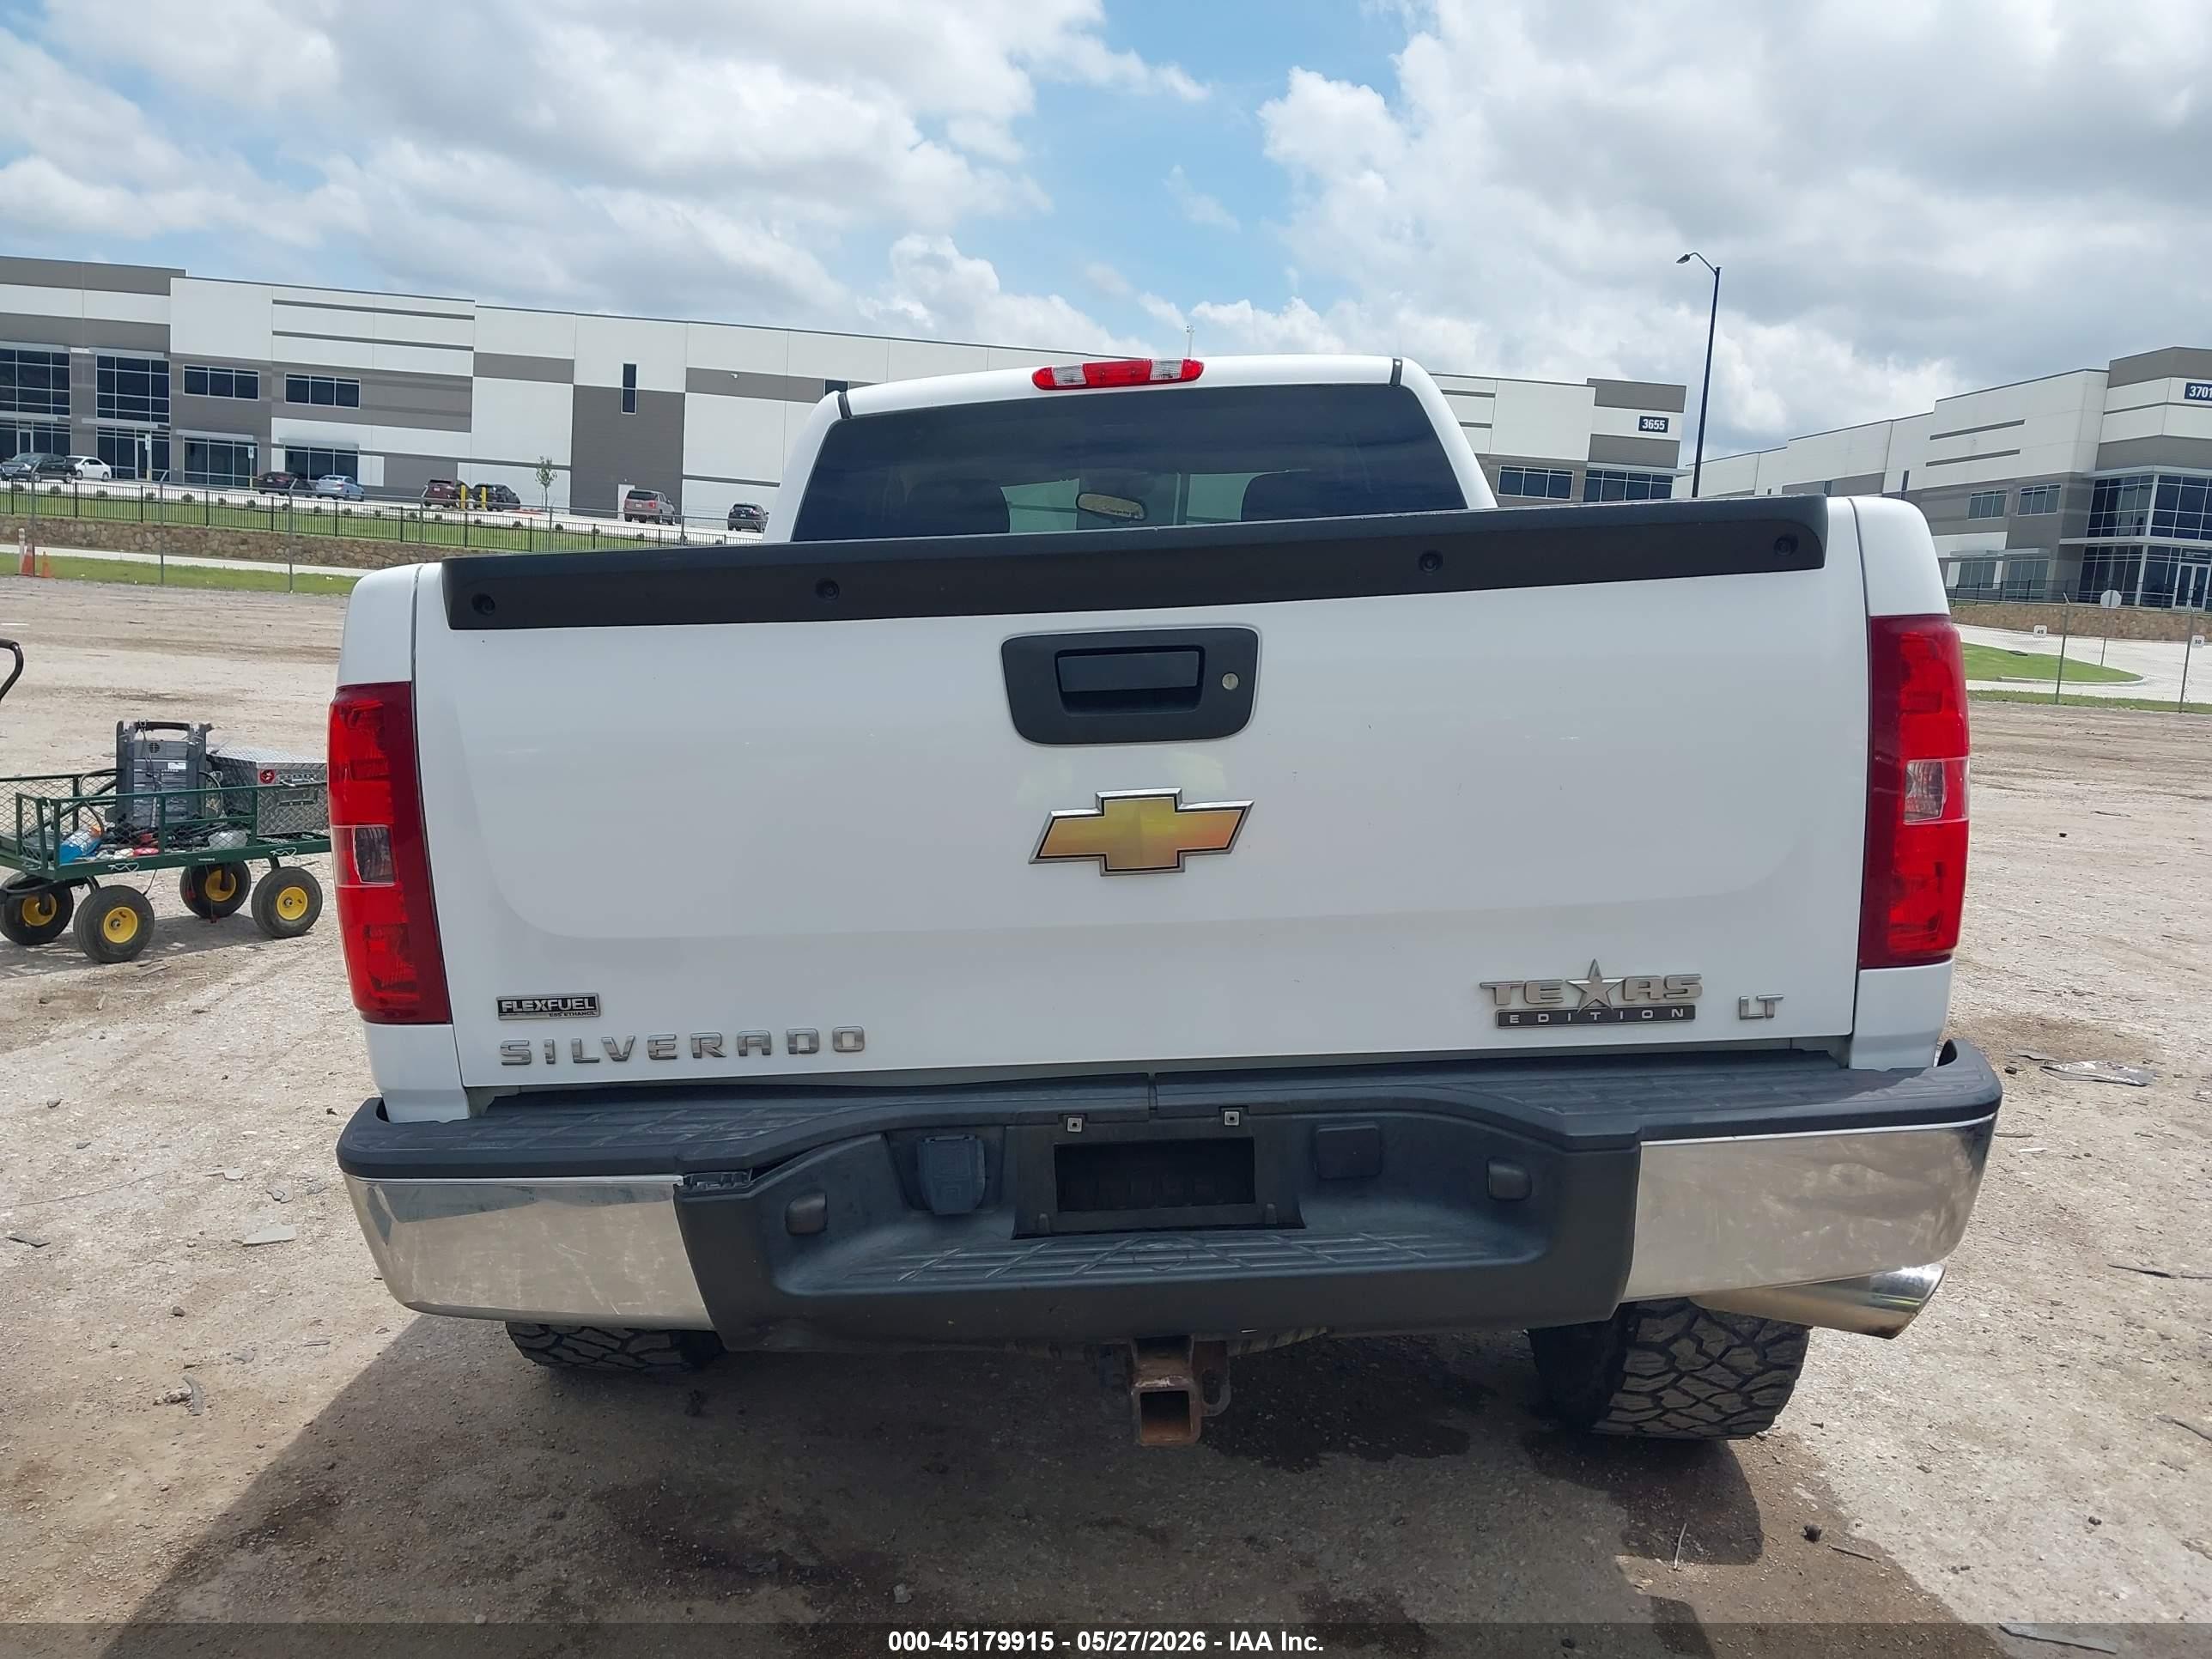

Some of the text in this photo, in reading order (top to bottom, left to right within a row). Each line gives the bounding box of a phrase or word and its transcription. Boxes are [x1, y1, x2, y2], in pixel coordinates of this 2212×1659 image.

[1642, 418, 1665, 430] 3655
[501, 998, 595, 1012] FLEXFUEL
[1738, 994, 1784, 1020] LT
[1509, 1008, 1684, 1024] EDITION
[500, 1025, 866, 1066] SILVERADO
